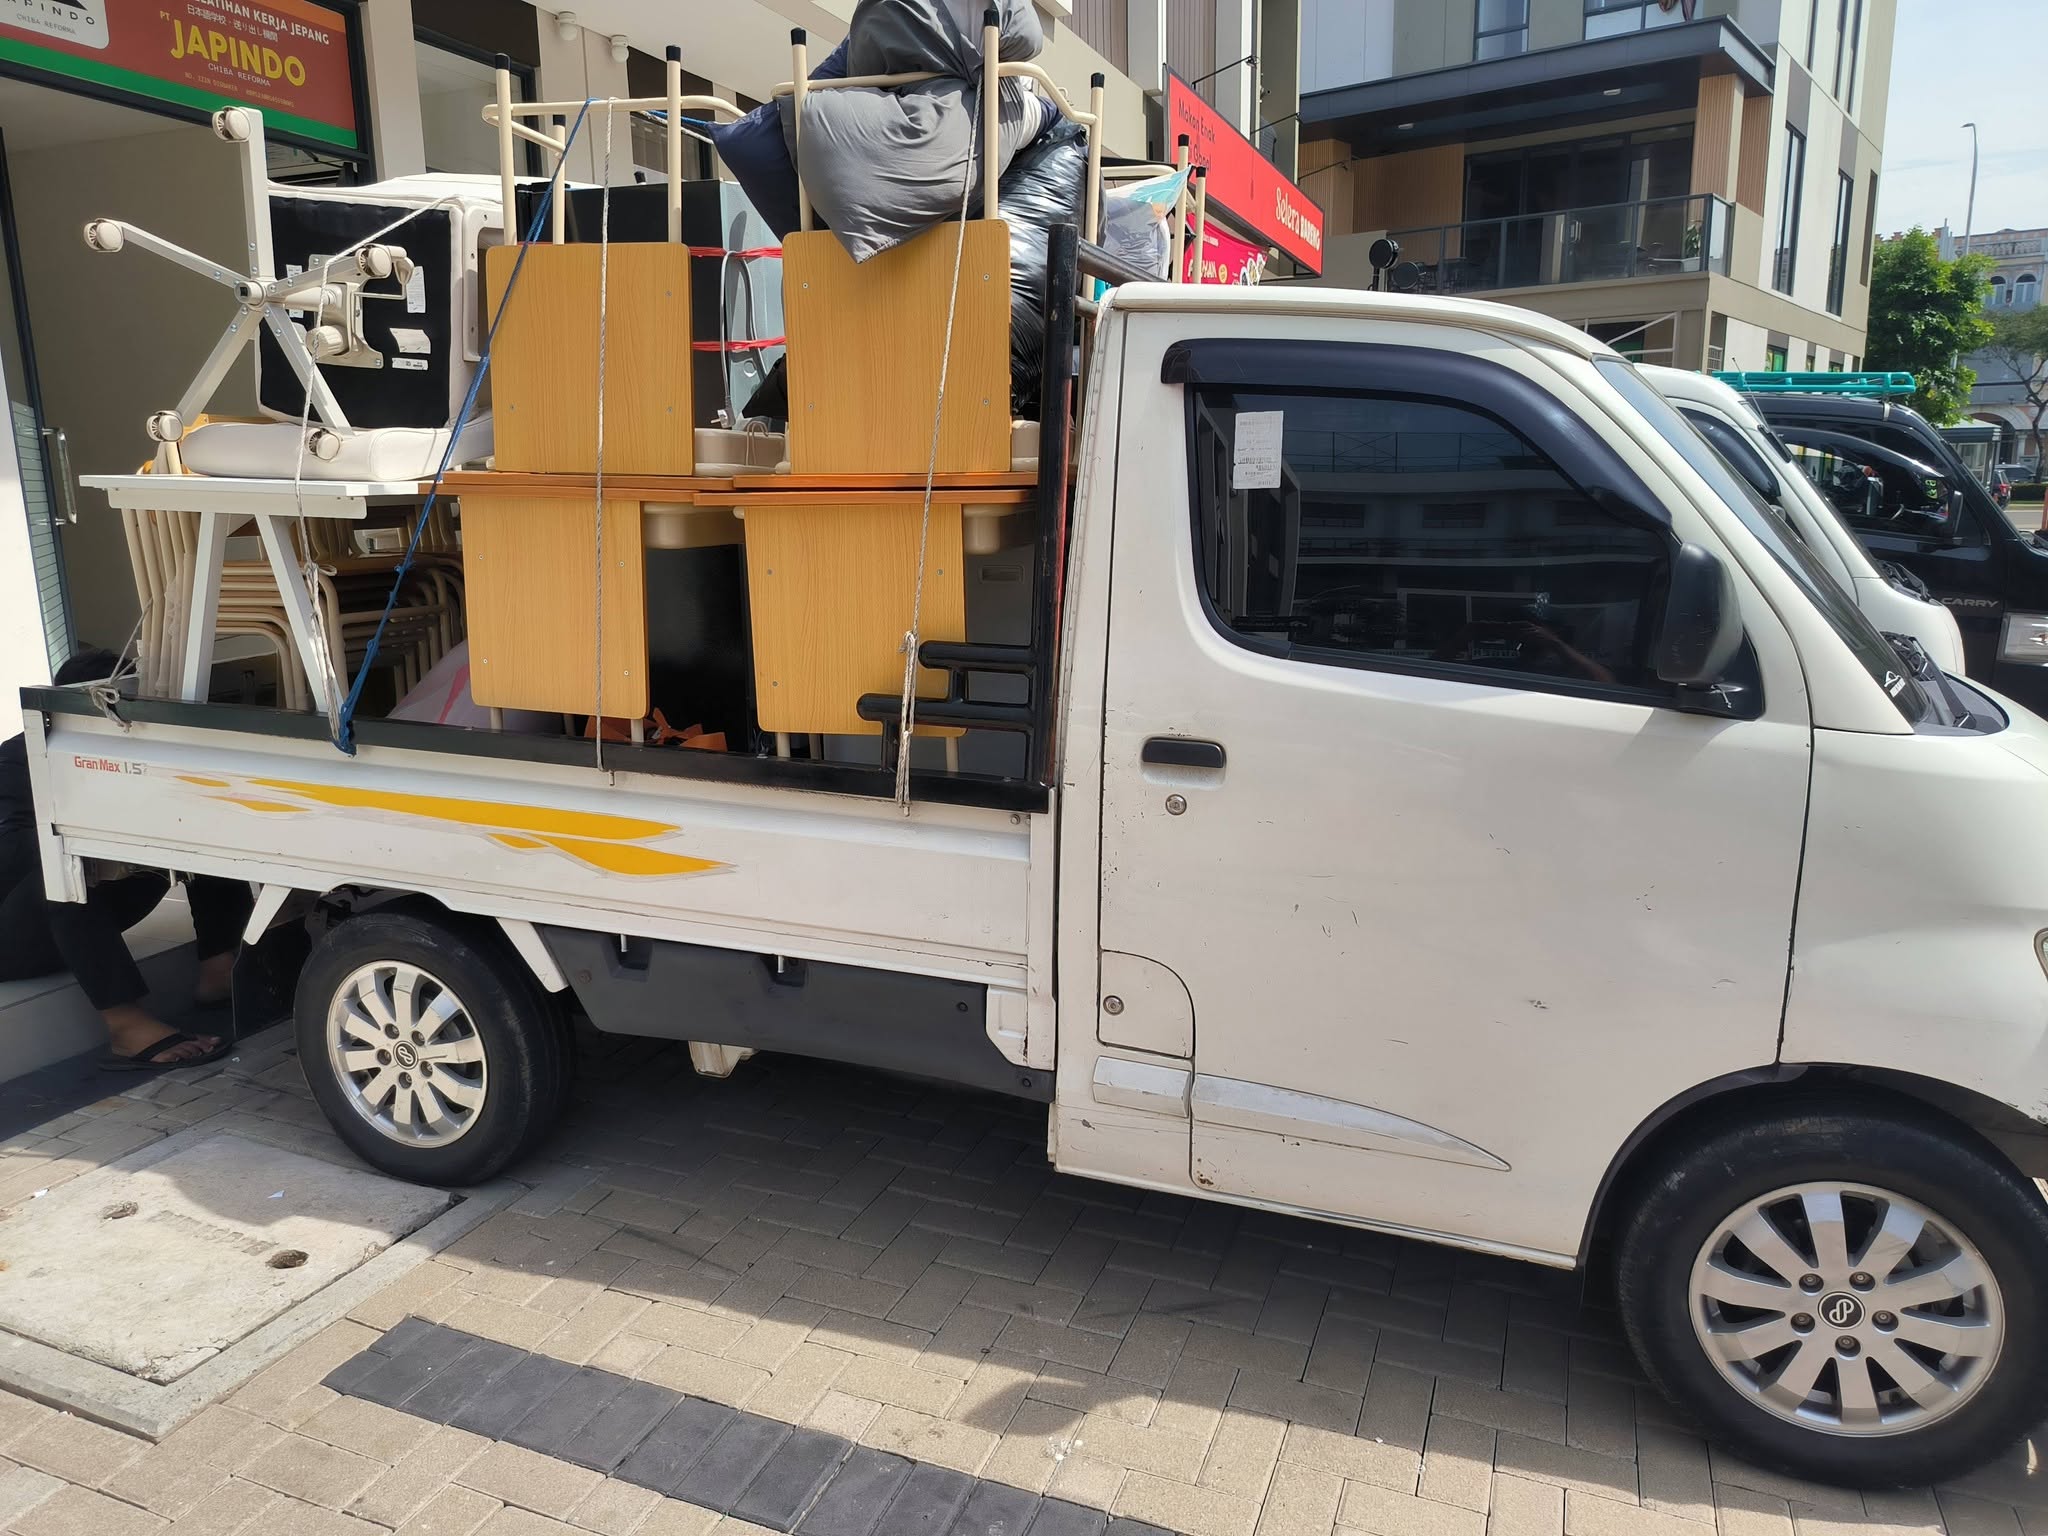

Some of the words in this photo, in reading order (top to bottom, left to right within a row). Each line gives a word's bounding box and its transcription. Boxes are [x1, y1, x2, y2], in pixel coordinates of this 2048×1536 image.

[16, 13, 41, 25] CHIBA
[44, 21, 76, 35] REFORMA
[159, 10, 170, 21] PT
[253, 9, 288, 31] KERJA
[290, 21, 329, 45] JEPANG
[170, 19, 306, 87] JAPINDO
[208, 62, 233, 76] CHIBA
[237, 71, 272, 87] REFORMA
[1178, 98, 1200, 132] Makan
[1200, 116, 1216, 144] Enak
[1276, 187, 1300, 236] Selera
[1941, 597, 2000, 608] CARRY
[74, 755, 98, 770] Gran
[99, 758, 120, 773] Max
